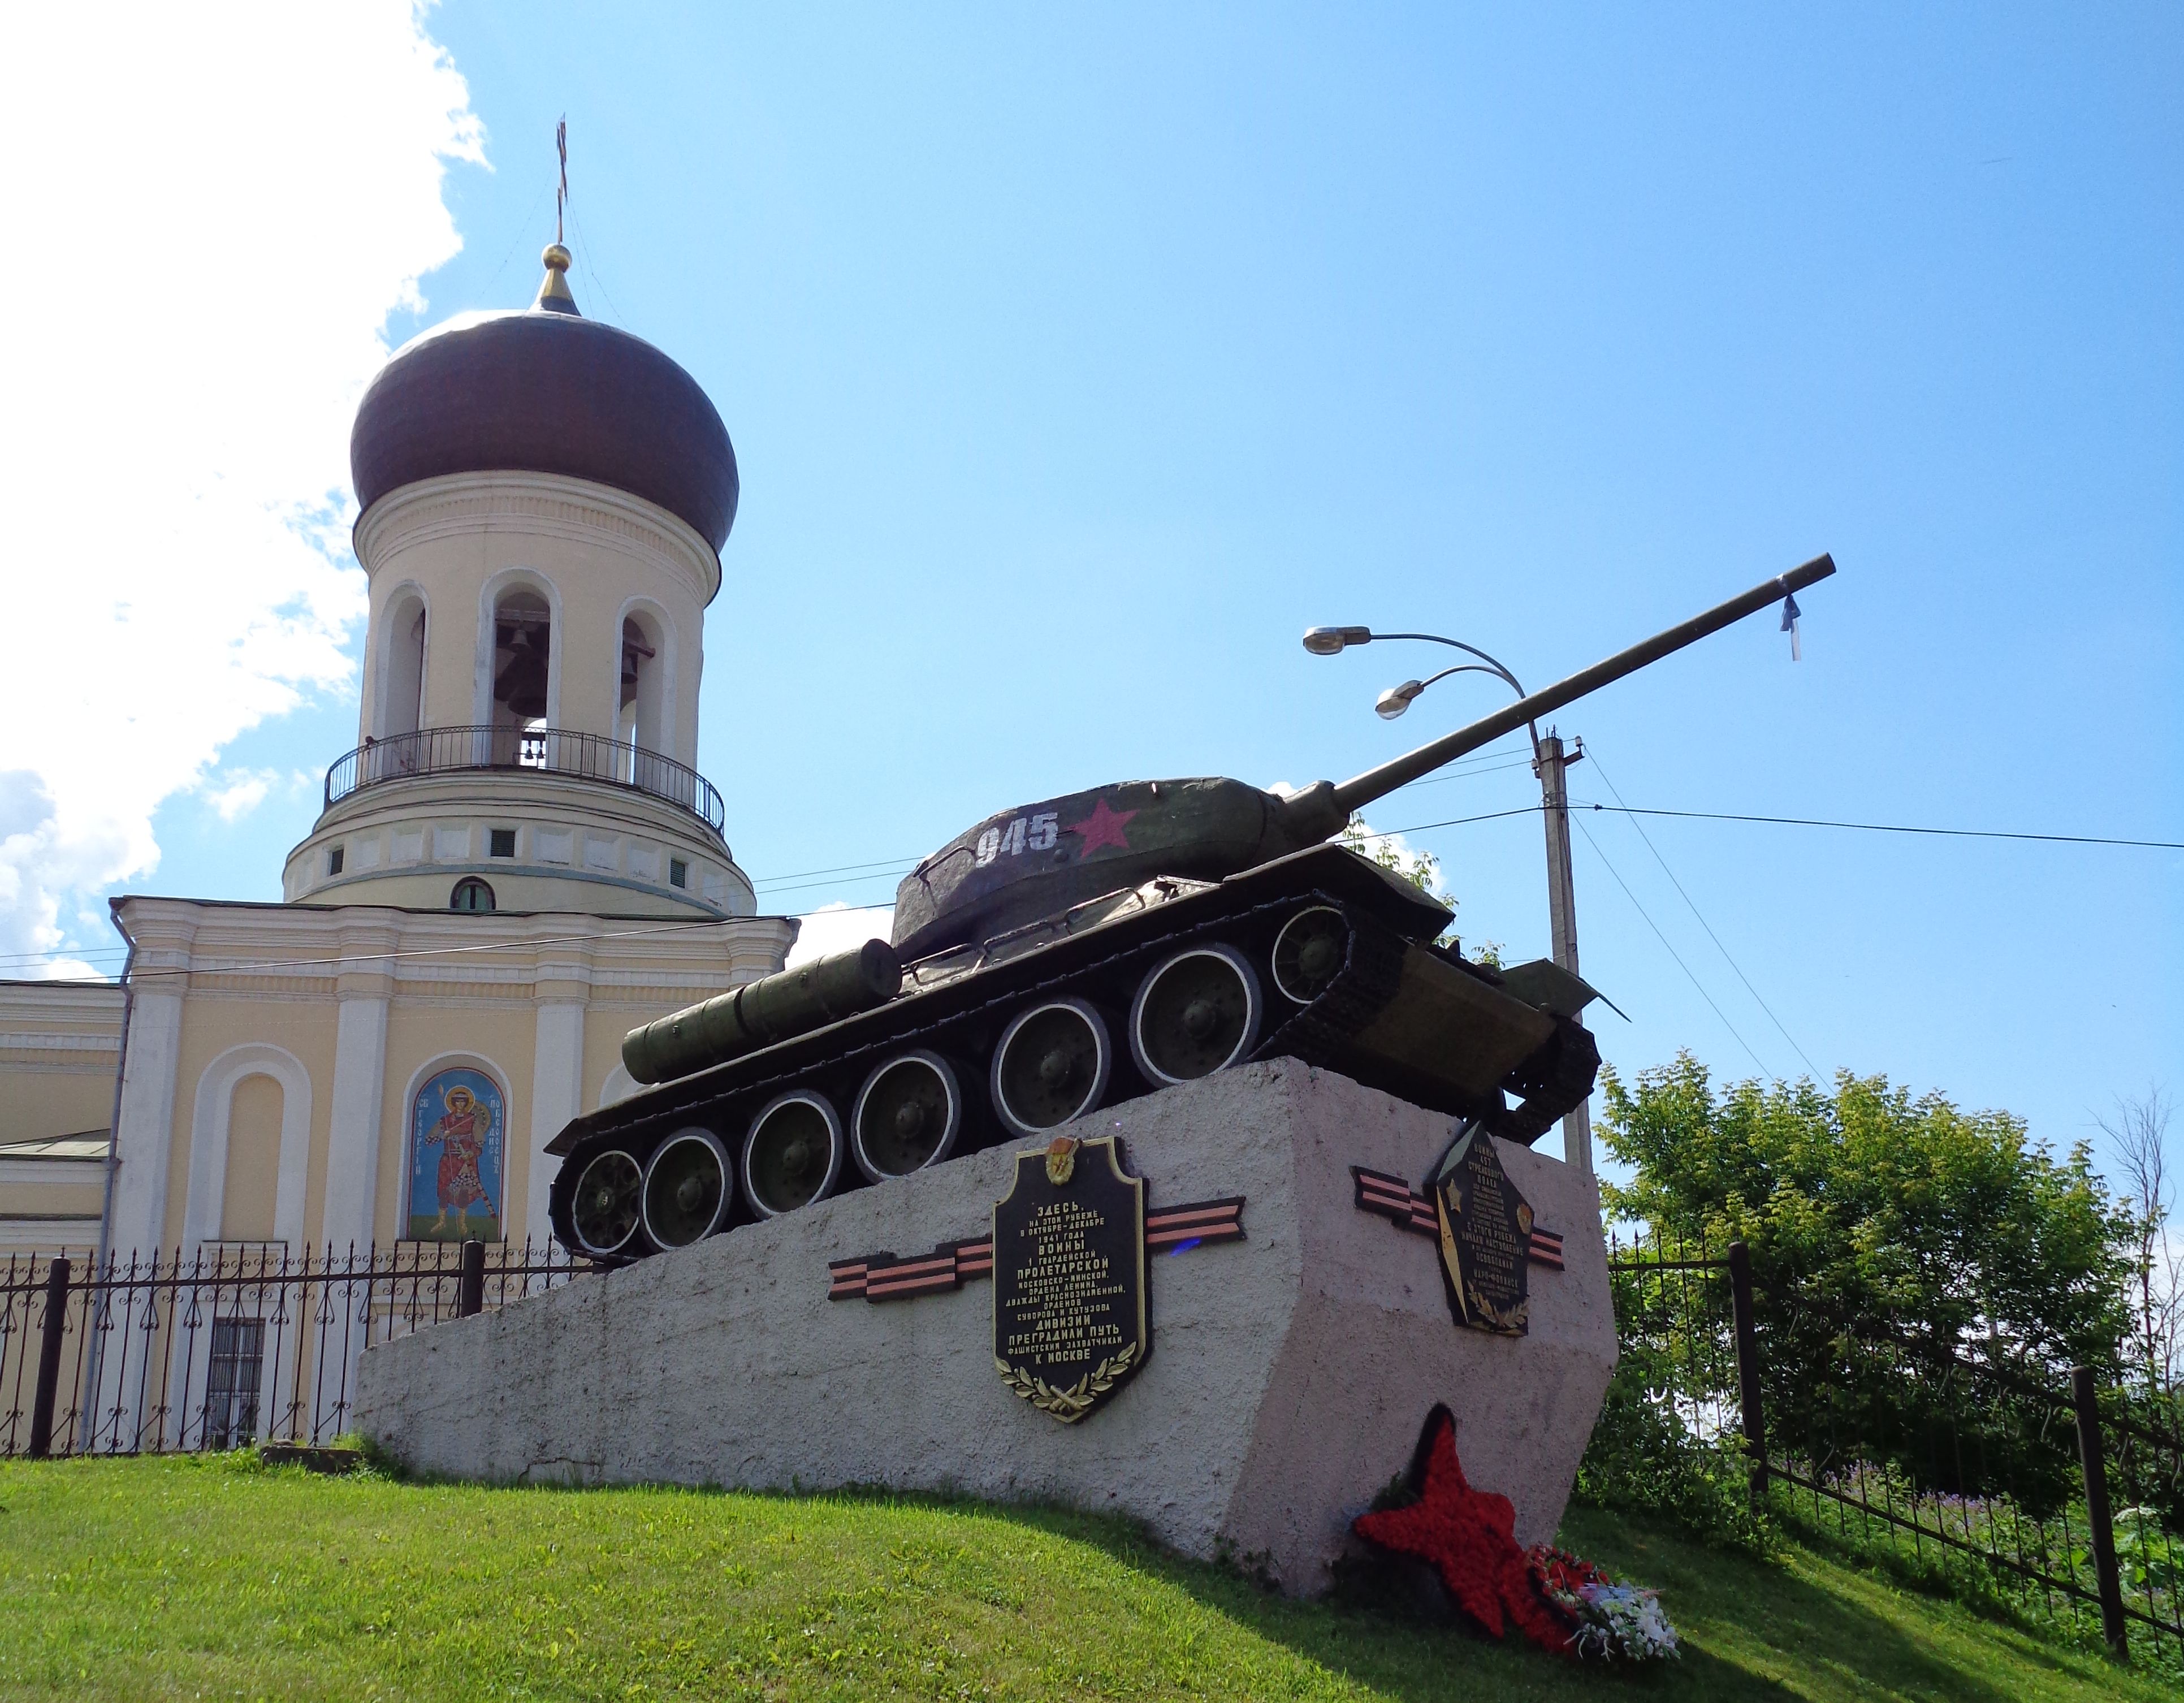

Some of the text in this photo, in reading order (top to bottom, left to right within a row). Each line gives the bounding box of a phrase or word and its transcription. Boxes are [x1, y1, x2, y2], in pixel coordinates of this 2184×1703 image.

[975, 811, 1059, 868] 945
[1468, 1161, 1504, 1181] СТРЕЛКОВОГО
[1043, 1217, 1061, 1225] ЭТОМ
[1066, 1211, 1097, 1221] РУБЕЖЕ
[1029, 1218, 1105, 1235] ОКТЯБРЕ-ДЕКАБРЕ
[1474, 1224, 1491, 1237] ЭТОГО
[1494, 1230, 1516, 1244] РУБЕЖА
[1039, 1231, 1084, 1243] 1941 ГОДА
[1039, 1239, 1084, 1255] ВОИНЫ
[1486, 1238, 1523, 1256] НАСТУПЛЕНИЕ
[1039, 1249, 1096, 1265] ГВАРДЕЙСКОЙ
[1018, 1255, 1108, 1280] ПРОЛЕТАРСКОЙ
[1029, 1285, 1059, 1295] ОРДЕНА
[1006, 1296, 1040, 1307] ДВАЖДЫ
[1044, 1298, 1081, 1309] ОРДЕНОВ
[1017, 1310, 1055, 1321] СУВОРОВА
[1069, 1303, 1110, 1315] КУТУЗОВА
[1036, 1315, 1091, 1330] ДИВИЗИИ
[1009, 1324, 1119, 1346] ПРЕГРАДИЛИ ПУТЬ
[1008, 1335, 1122, 1355] ФАШИСТСКИМ ЗАХВАТЧИКАМ
[1035, 1348, 1090, 1364] К МОСКВЕ
